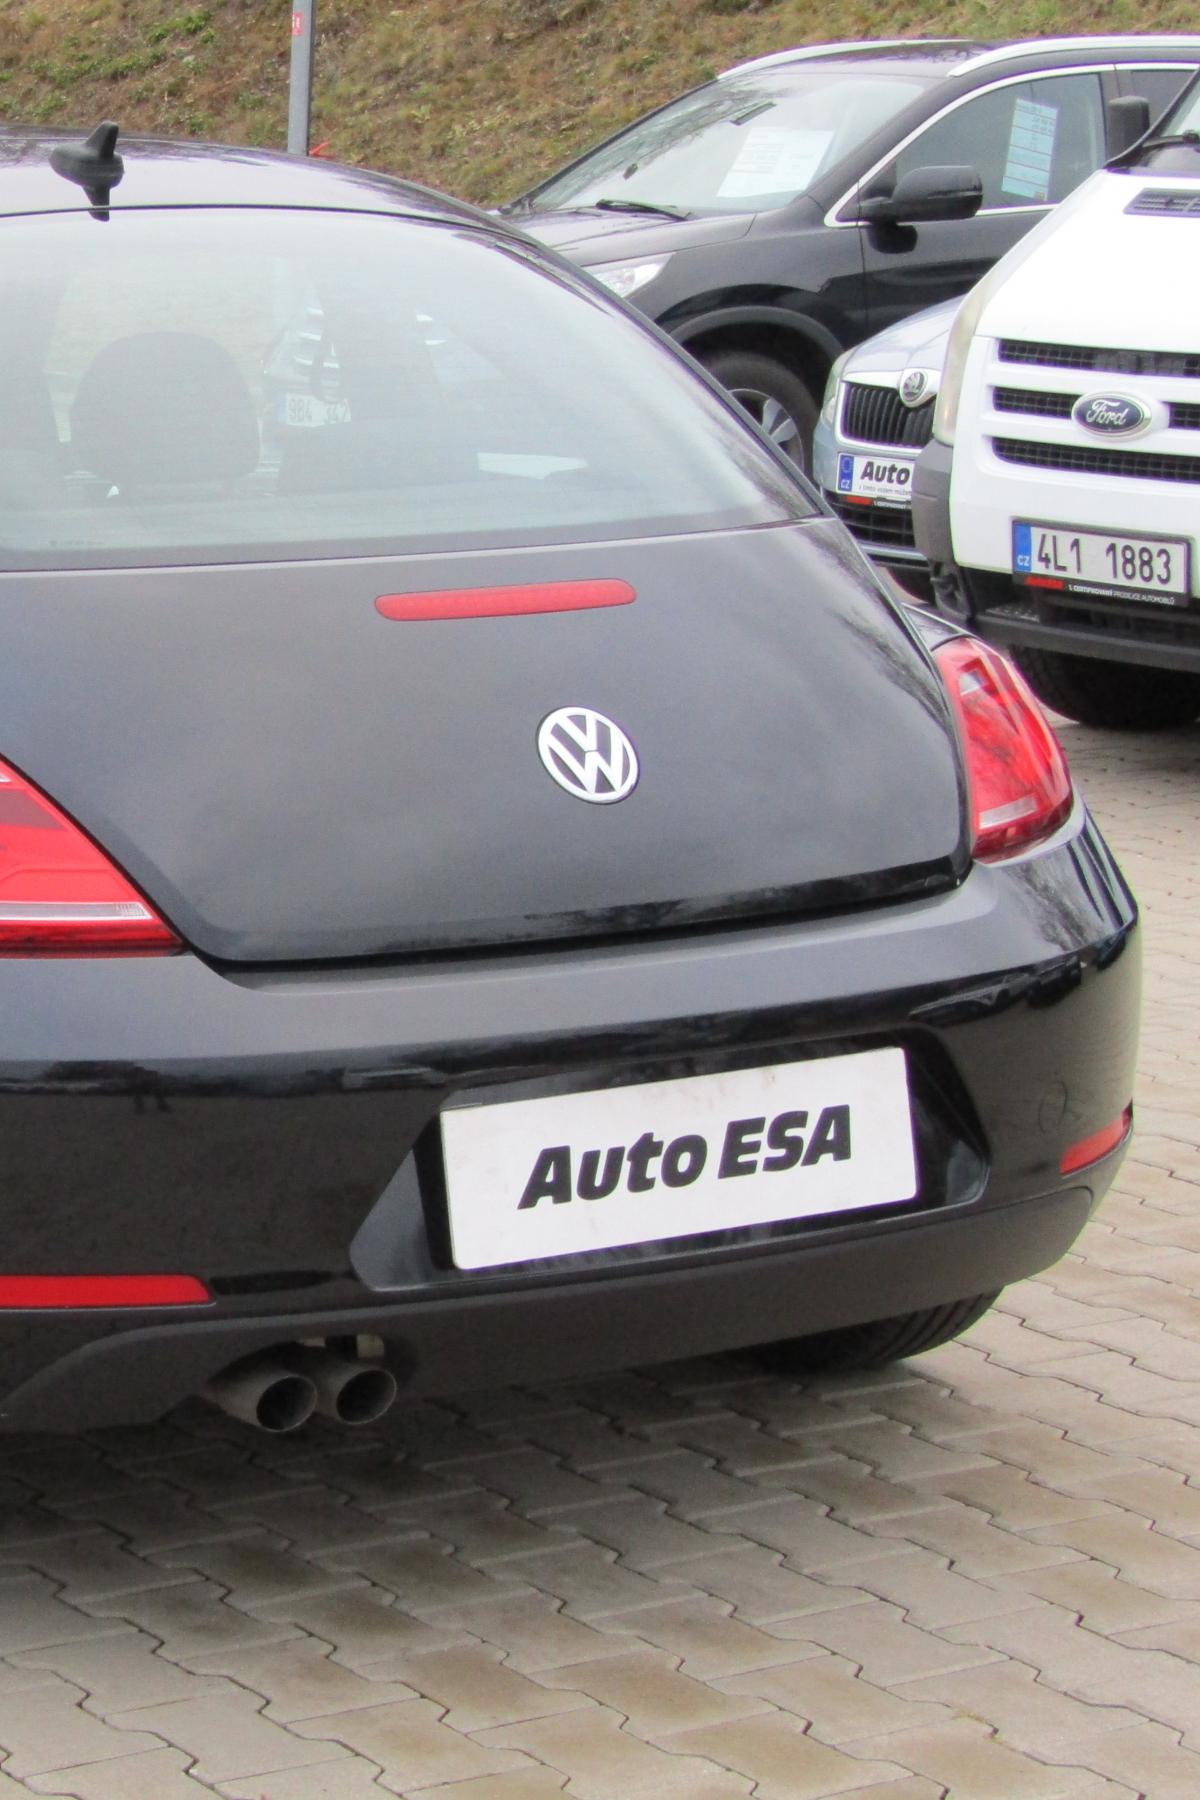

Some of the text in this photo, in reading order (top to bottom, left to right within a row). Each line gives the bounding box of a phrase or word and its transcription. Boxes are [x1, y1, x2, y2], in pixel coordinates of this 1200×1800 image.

[1086, 398, 1130, 426] Ford
[840, 478, 850, 490] CZ
[860, 461, 911, 486] Auto
[1017, 554, 1030, 567] CZ
[1037, 532, 1171, 585] 4L1 1883
[517, 1103, 852, 1210] Auto ESA
